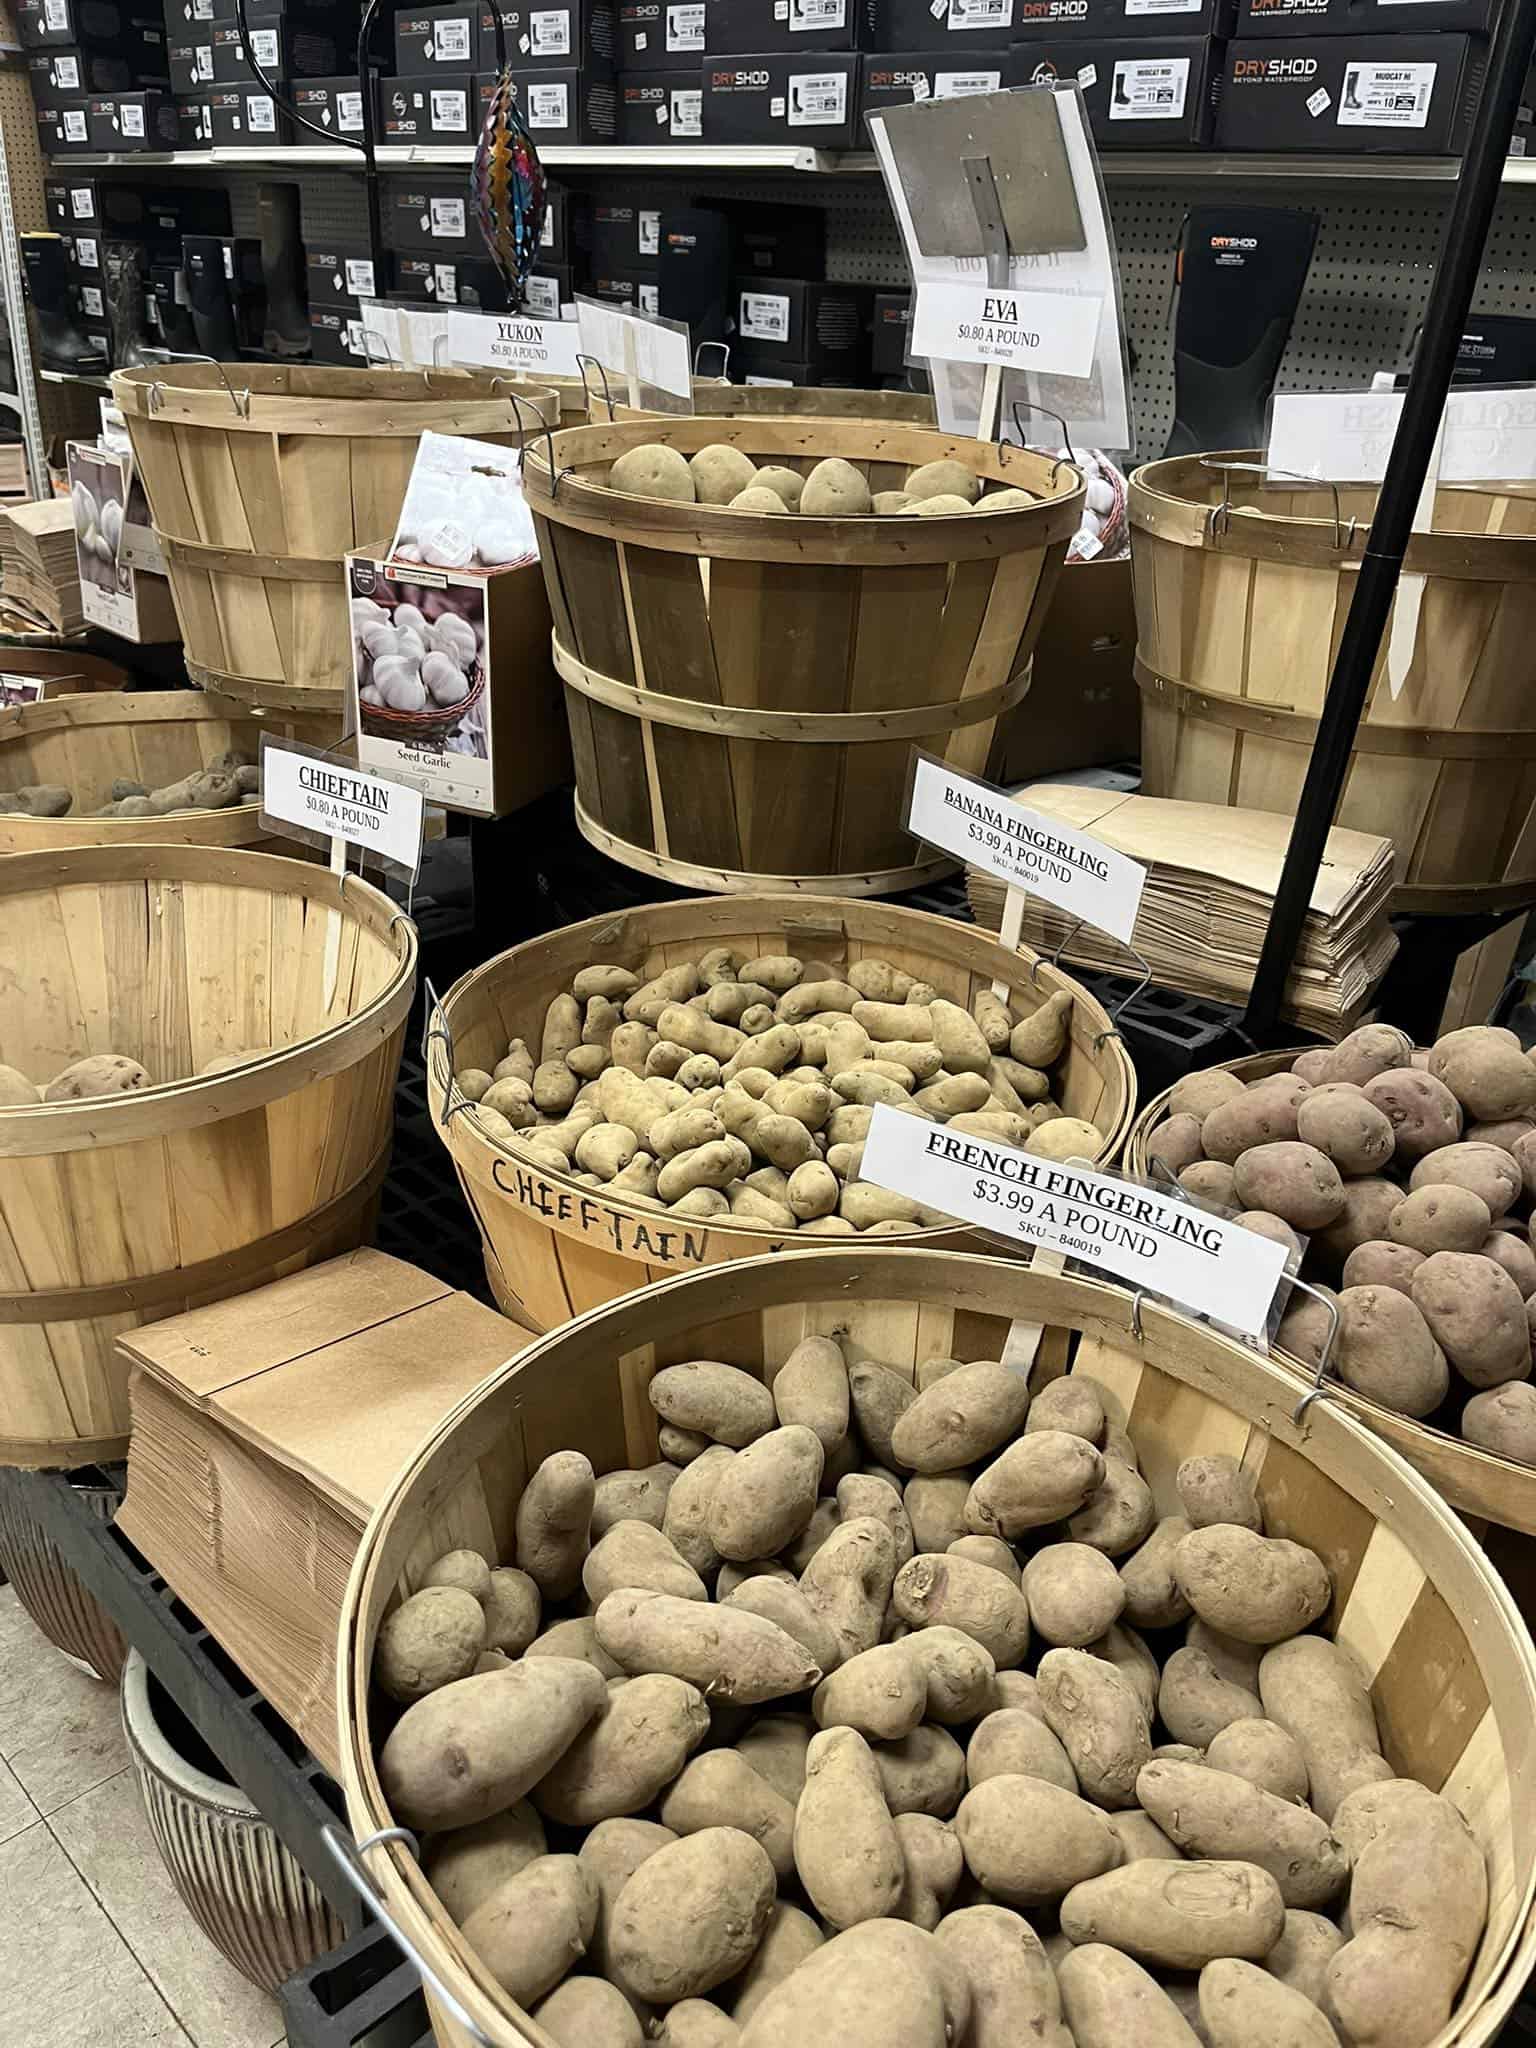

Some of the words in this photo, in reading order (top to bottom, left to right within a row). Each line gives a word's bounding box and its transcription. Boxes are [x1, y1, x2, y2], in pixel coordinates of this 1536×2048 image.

[1024, 1, 1088, 16] DRYSHOD
[712, 71, 769, 85] DRYSHOD
[1234, 58, 1318, 75] DRYSHOD
[982, 298, 1018, 321] EVA
[498, 323, 543, 341] YUKON
[958, 324, 984, 340] $0.80
[986, 328, 994, 342] A
[997, 329, 1040, 347] POUND
[491, 344, 511, 356] $0.80
[512, 346, 519, 358] A
[520, 347, 548, 360] POUND
[398, 749, 419, 762] Seed
[423, 754, 452, 768] Garlic
[299, 766, 389, 810] CHIEFTAIN
[306, 795, 329, 814] $0.80
[331, 805, 339, 819] A
[342, 807, 380, 830] POUND
[945, 787, 1003, 829] BANANA
[1007, 818, 1109, 877] FINGERLING
[968, 823, 1001, 850] $3.99
[1002, 843, 1014, 858] A
[1016, 847, 1072, 884] POUND
[992, 854, 1008, 868] SKU
[1014, 865, 1039, 883] 840019
[926, 1132, 1041, 1185] FRENCH
[1045, 1171, 1223, 1252] FINGERLING
[492, 1158, 708, 1263] CHIEFTAIN
[973, 1179, 1034, 1214] $3.99
[1038, 1203, 1057, 1223] A
[1064, 1208, 1158, 1258] POUND
[1018, 1220, 1047, 1237] SKU
[1059, 1234, 1101, 1256] 840019
